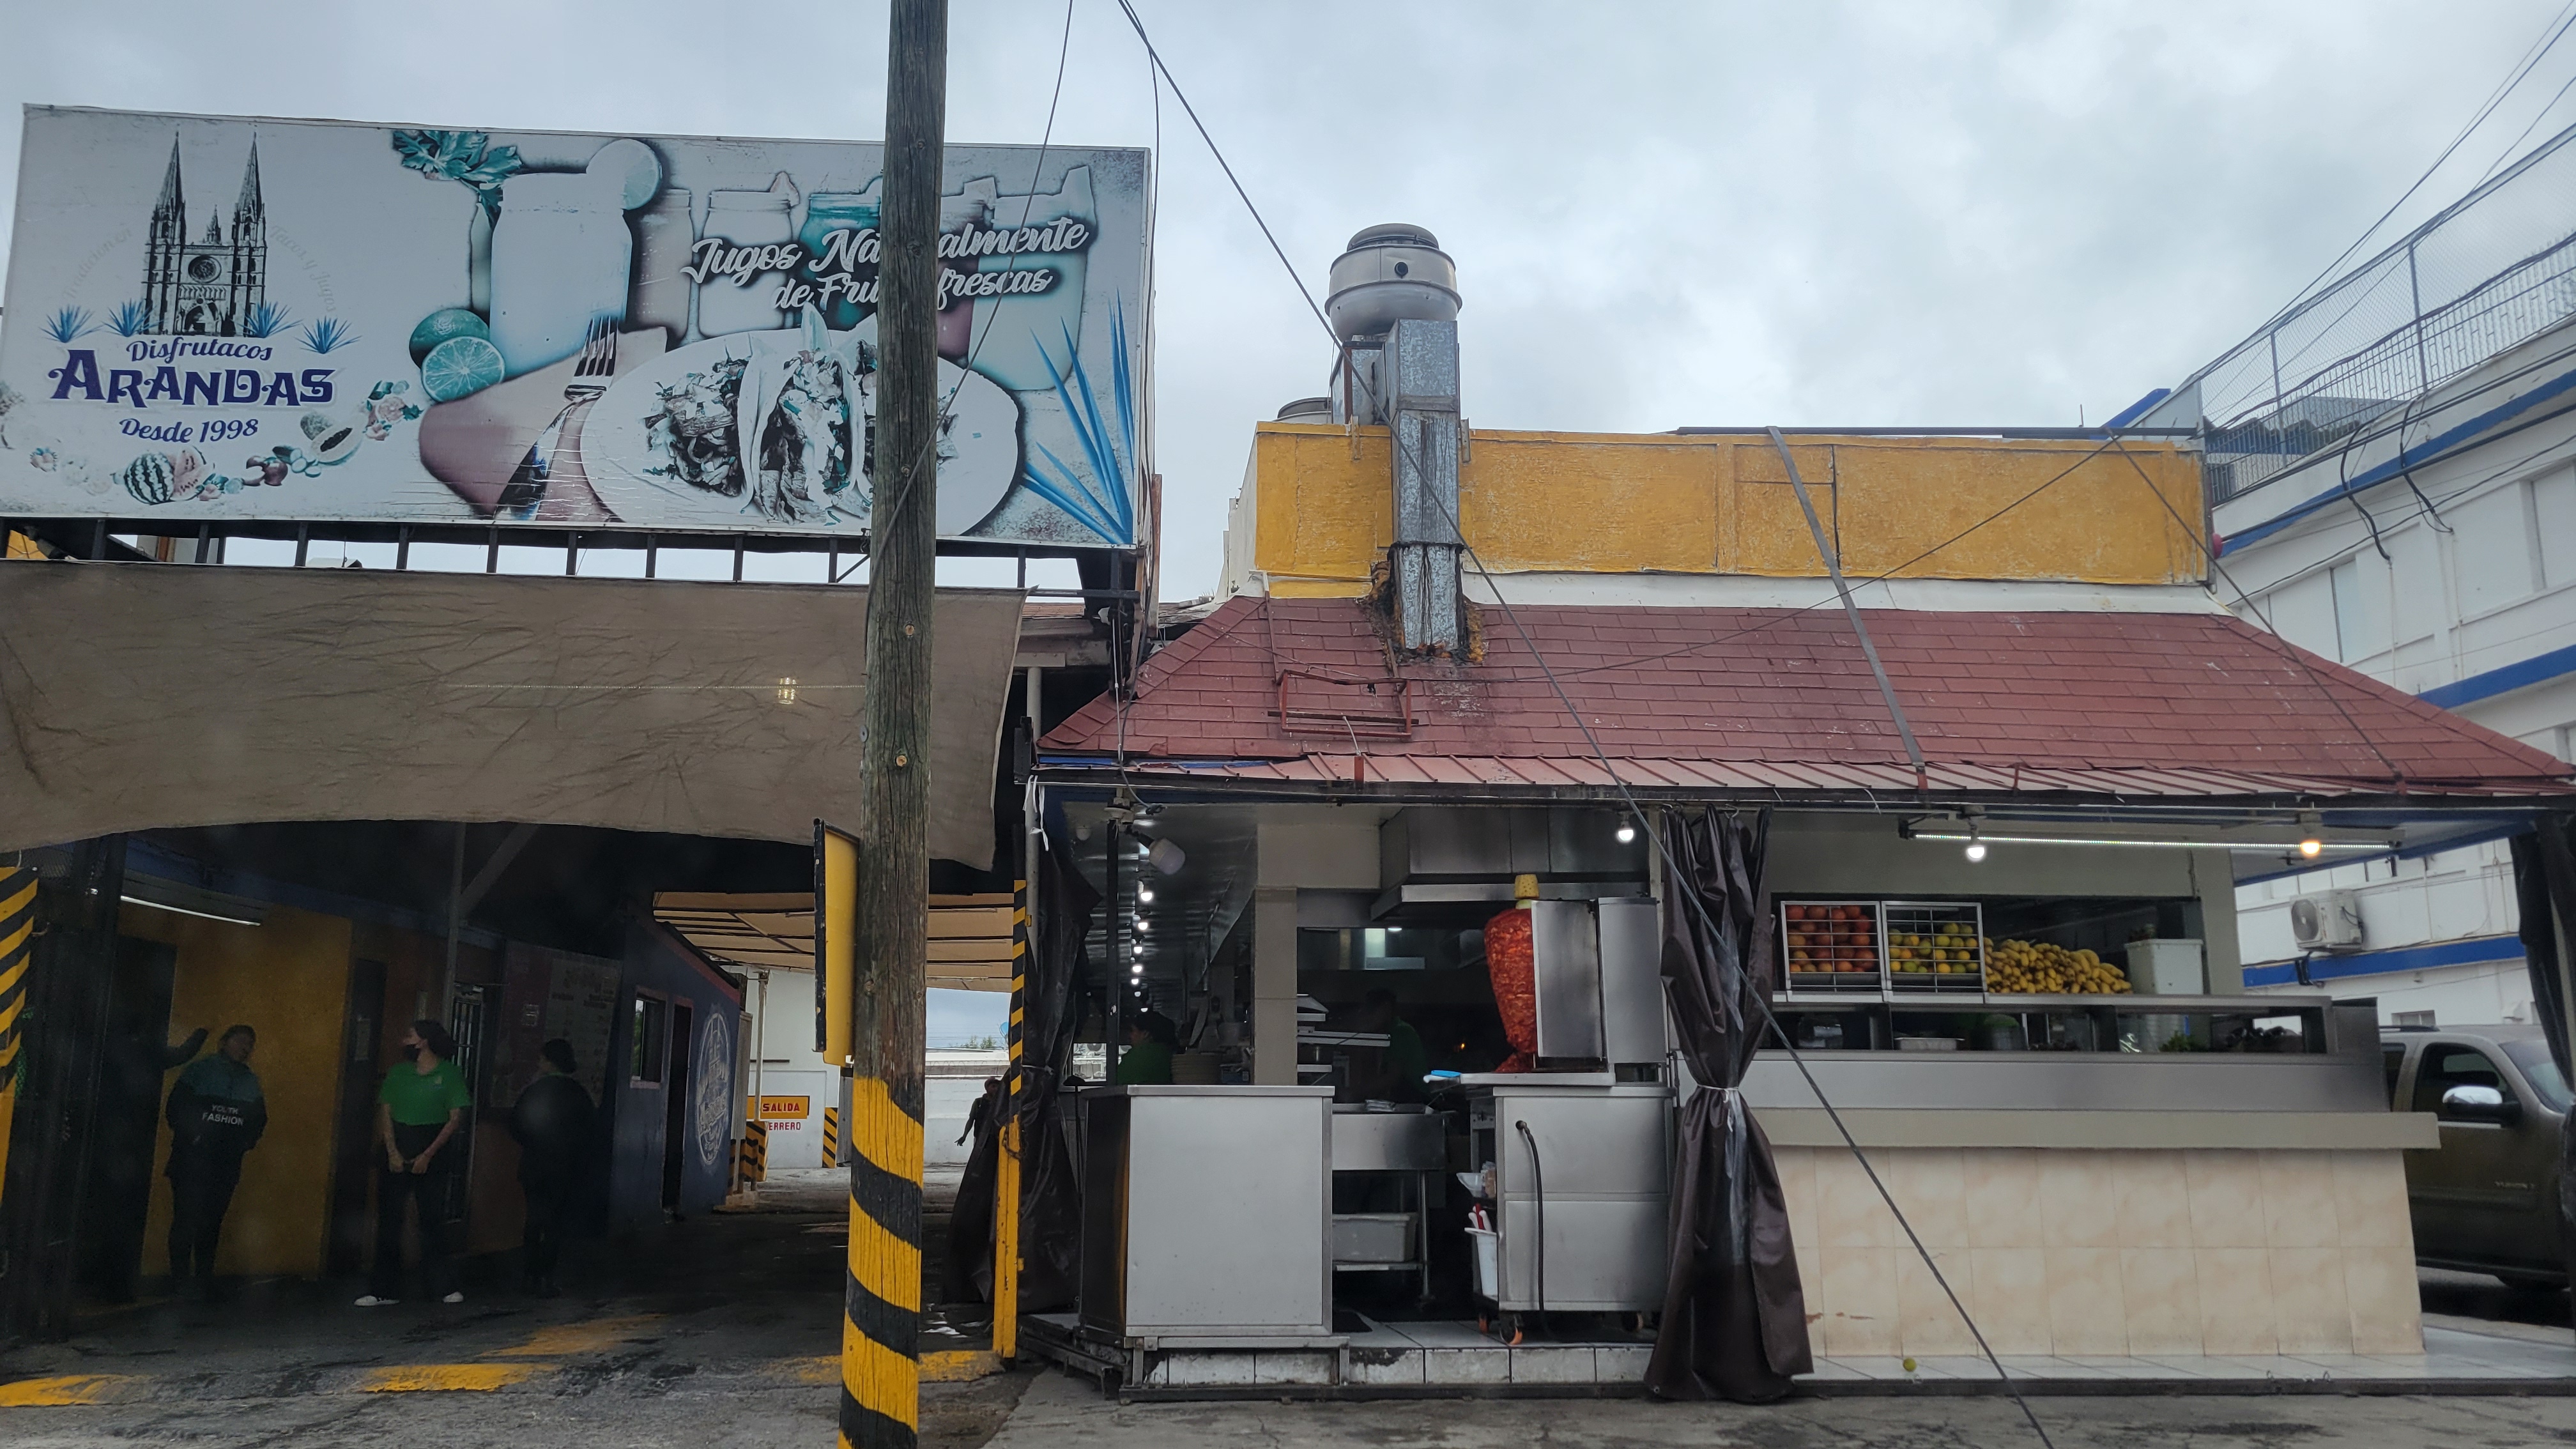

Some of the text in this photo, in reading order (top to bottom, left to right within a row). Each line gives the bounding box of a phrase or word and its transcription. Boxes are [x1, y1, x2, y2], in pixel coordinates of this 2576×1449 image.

[680, 217, 1089, 287] Jugos Naalmente
[302, 259, 318, 270] y
[310, 271, 337, 312] Jugos
[772, 278, 815, 309] de
[816, 272, 879, 311] Fru
[126, 337, 273, 364] Disfrutacos
[48, 349, 336, 408] ARANDAS
[119, 418, 259, 443] Desde 1998
[202, 1112, 244, 1126] FASHION
[762, 1102, 801, 1112] SALIDA
[769, 1121, 801, 1131] ERRERO
